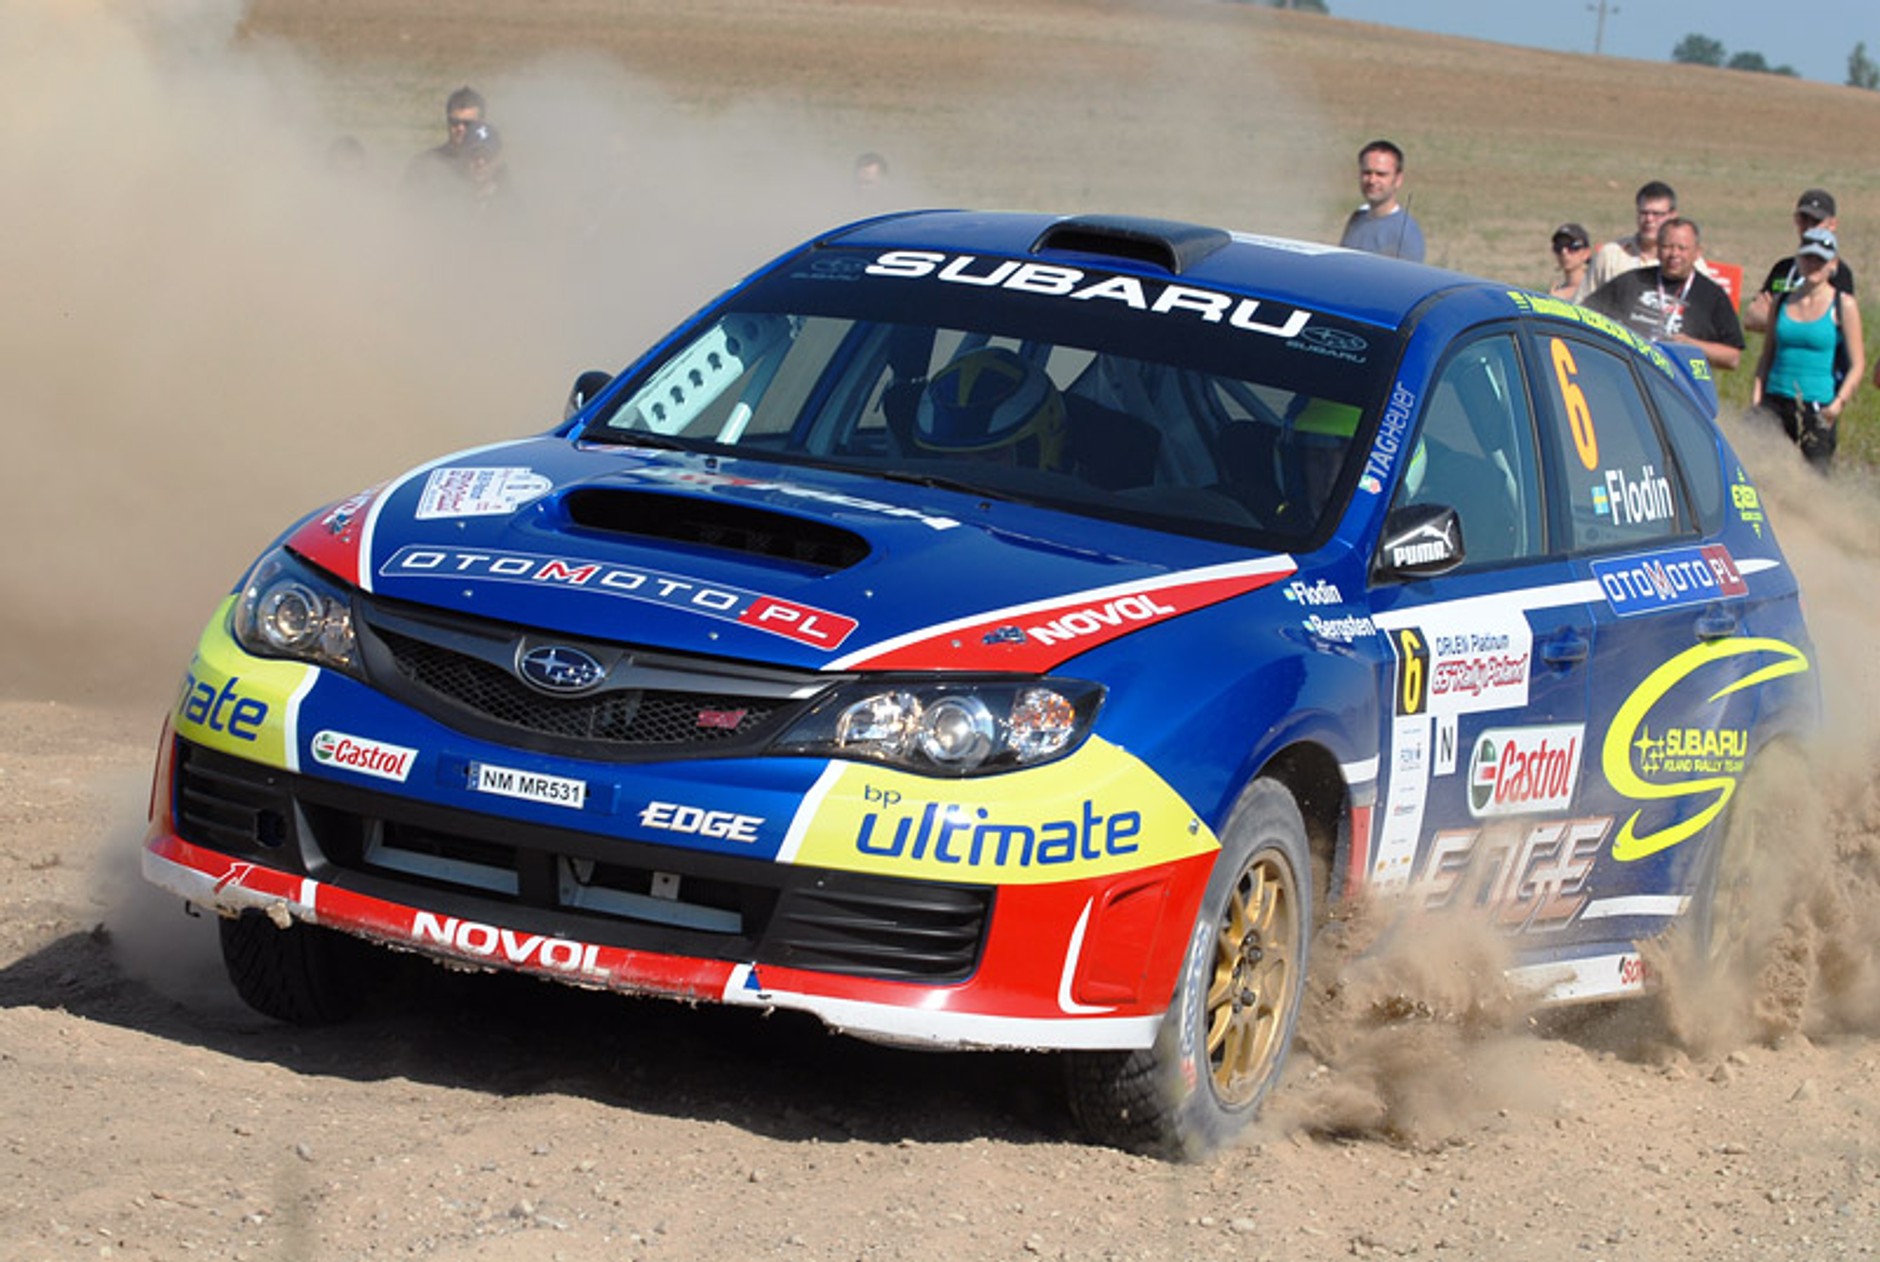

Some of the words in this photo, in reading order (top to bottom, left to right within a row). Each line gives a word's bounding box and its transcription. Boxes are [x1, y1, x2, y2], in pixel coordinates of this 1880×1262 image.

[865, 250, 1311, 338] SUBARU
[1550, 337, 1598, 471] 6
[1605, 465, 1674, 526] Flodin
[1393, 540, 1445, 568] PUMA
[1290, 579, 1343, 606] Flodin
[1026, 594, 1177, 647] NOVOL
[1309, 614, 1377, 643] Bergsten
[1401, 630, 1421, 714] 6
[335, 738, 408, 776] Castrol
[1440, 725, 1454, 763] N
[1665, 728, 1748, 757] SUBARU
[1495, 736, 1576, 805] Castrol
[1694, 759, 1723, 772] RALLY
[483, 770, 514, 790] NM
[518, 775, 580, 802] MR531
[865, 785, 902, 808] bp
[638, 801, 767, 844] EDGE
[855, 799, 1141, 867] ultimate
[411, 911, 612, 977] NOVOL
